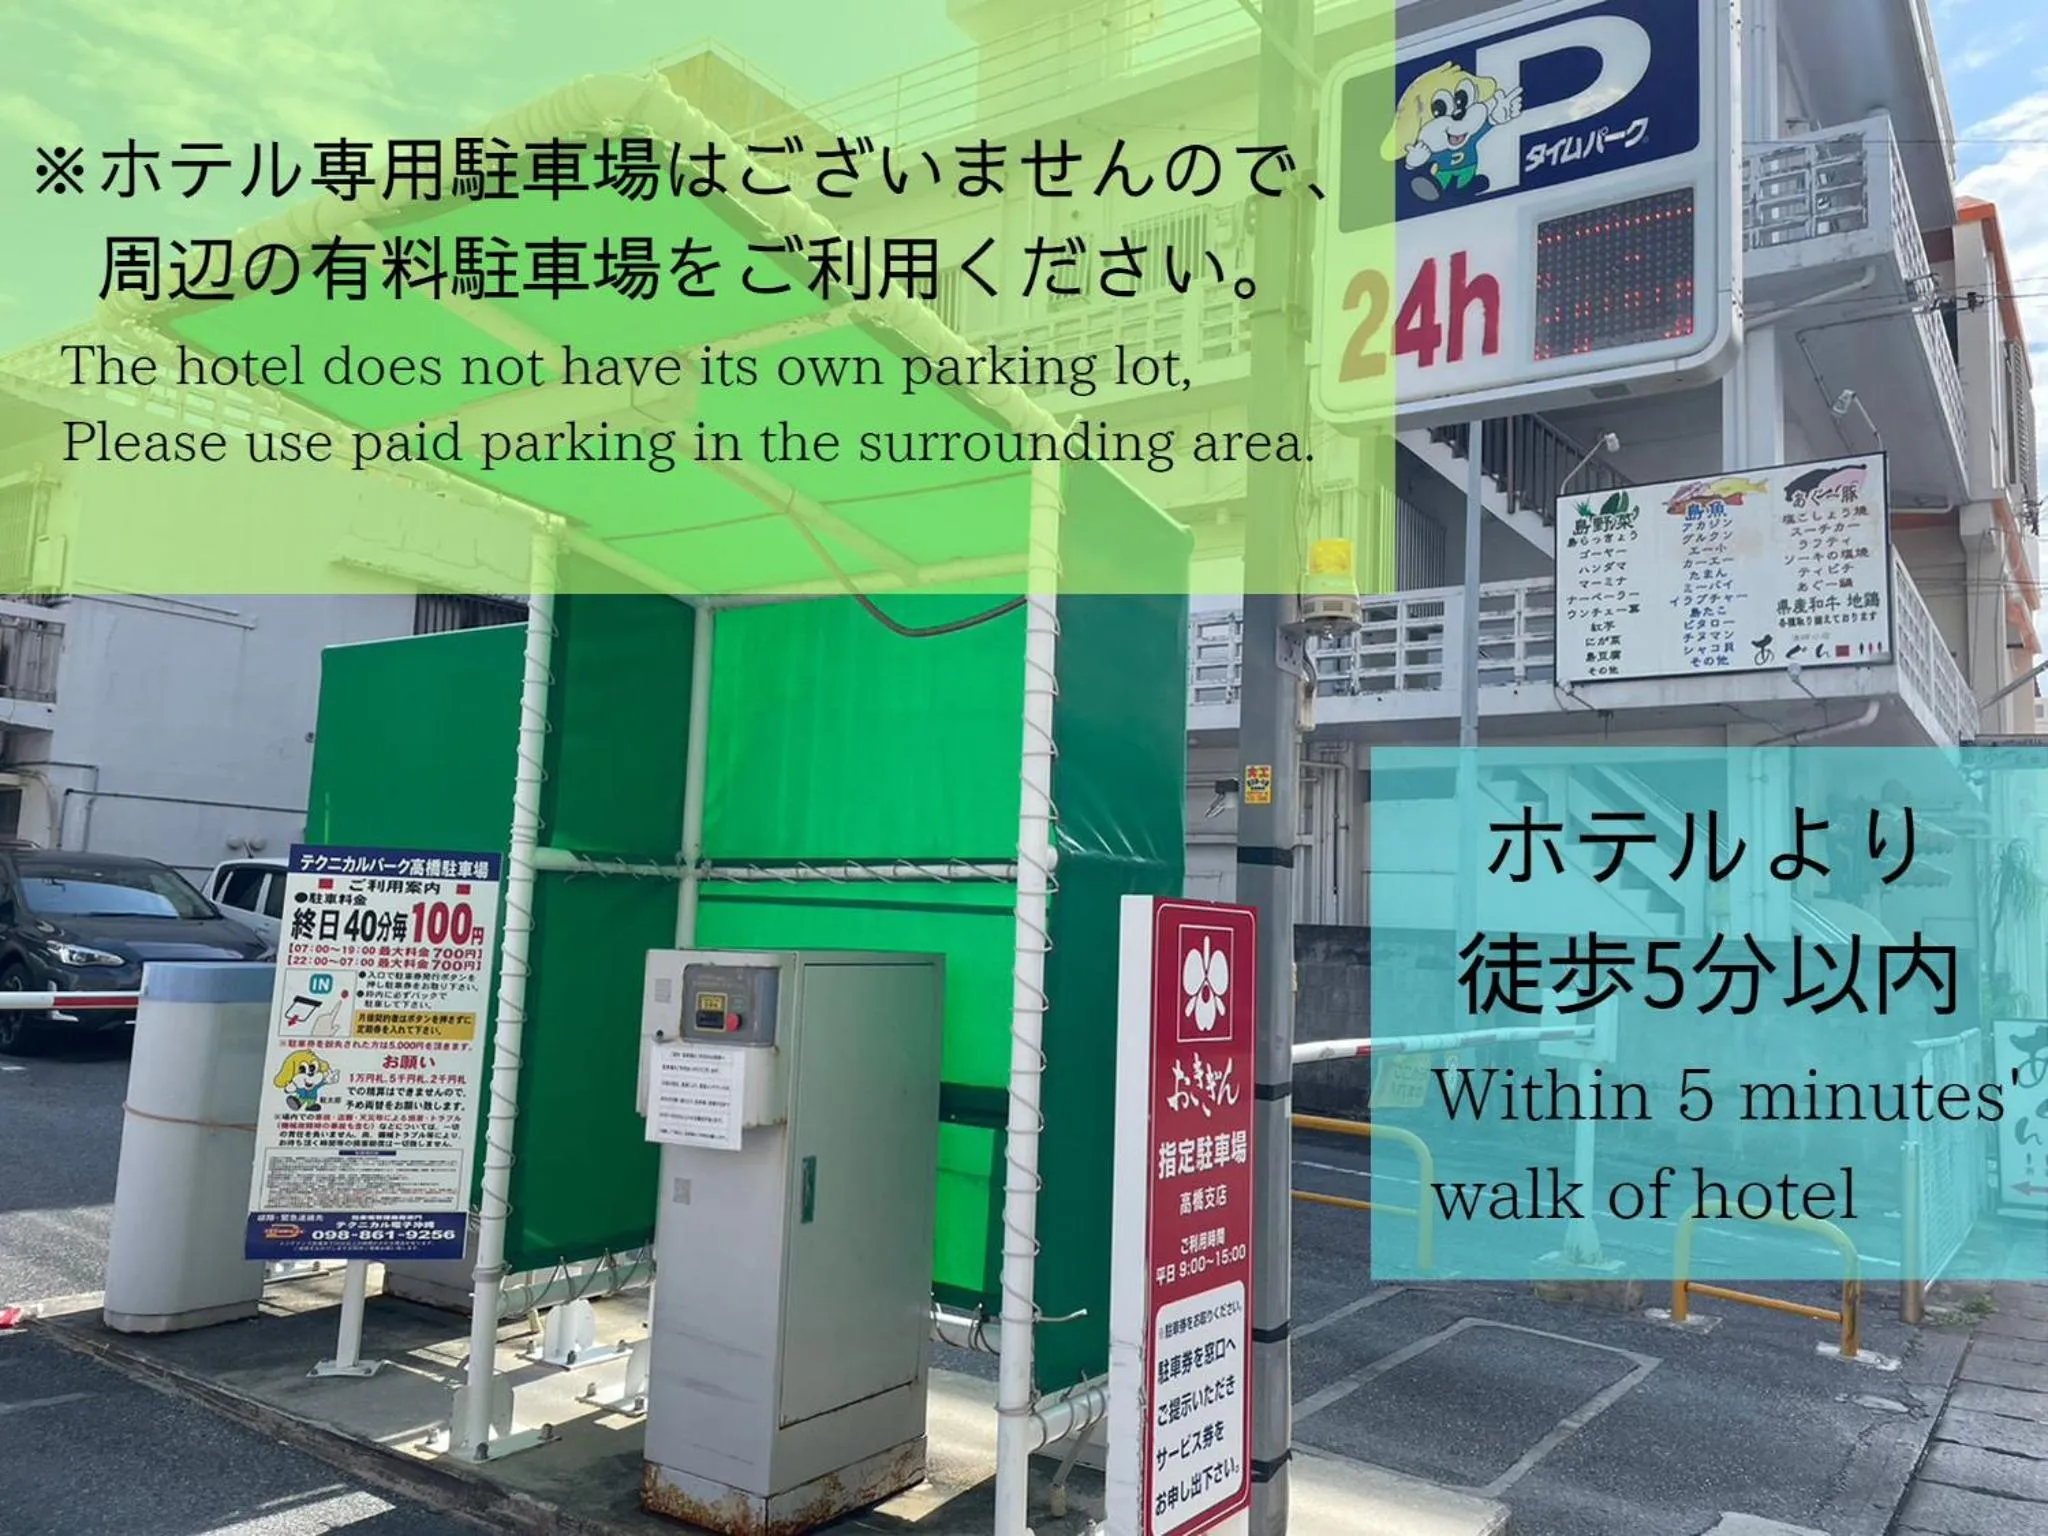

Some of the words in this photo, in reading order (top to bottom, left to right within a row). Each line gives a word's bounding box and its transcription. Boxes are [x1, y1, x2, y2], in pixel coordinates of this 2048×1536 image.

[1525, 117, 1649, 173] タイムパーク
[1339, 250, 1500, 382] 24h
[1685, 503, 1727, 520] 島魚
[1682, 531, 1733, 544] グルクン
[1579, 549, 1627, 559] ゴーヤー
[1579, 561, 1627, 574] ハンダマ
[1579, 576, 1627, 588] マーミナ
[300, 854, 489, 880] テクニカルパーク高橋駐車場
[349, 879, 441, 895] ご利用案内
[311, 975, 331, 991] IN
[382, 1055, 436, 1069] お願い
[1158, 1130, 1248, 1180] 指定駐車場
[311, 1229, 457, 1241] 098-861-9256
[1155, 1264, 1175, 1287] 平日
[1157, 1374, 1236, 1426] ご提示いただき
[1156, 1420, 1225, 1472] サービス券を
[1155, 1457, 1240, 1516] お申し出下さい。
